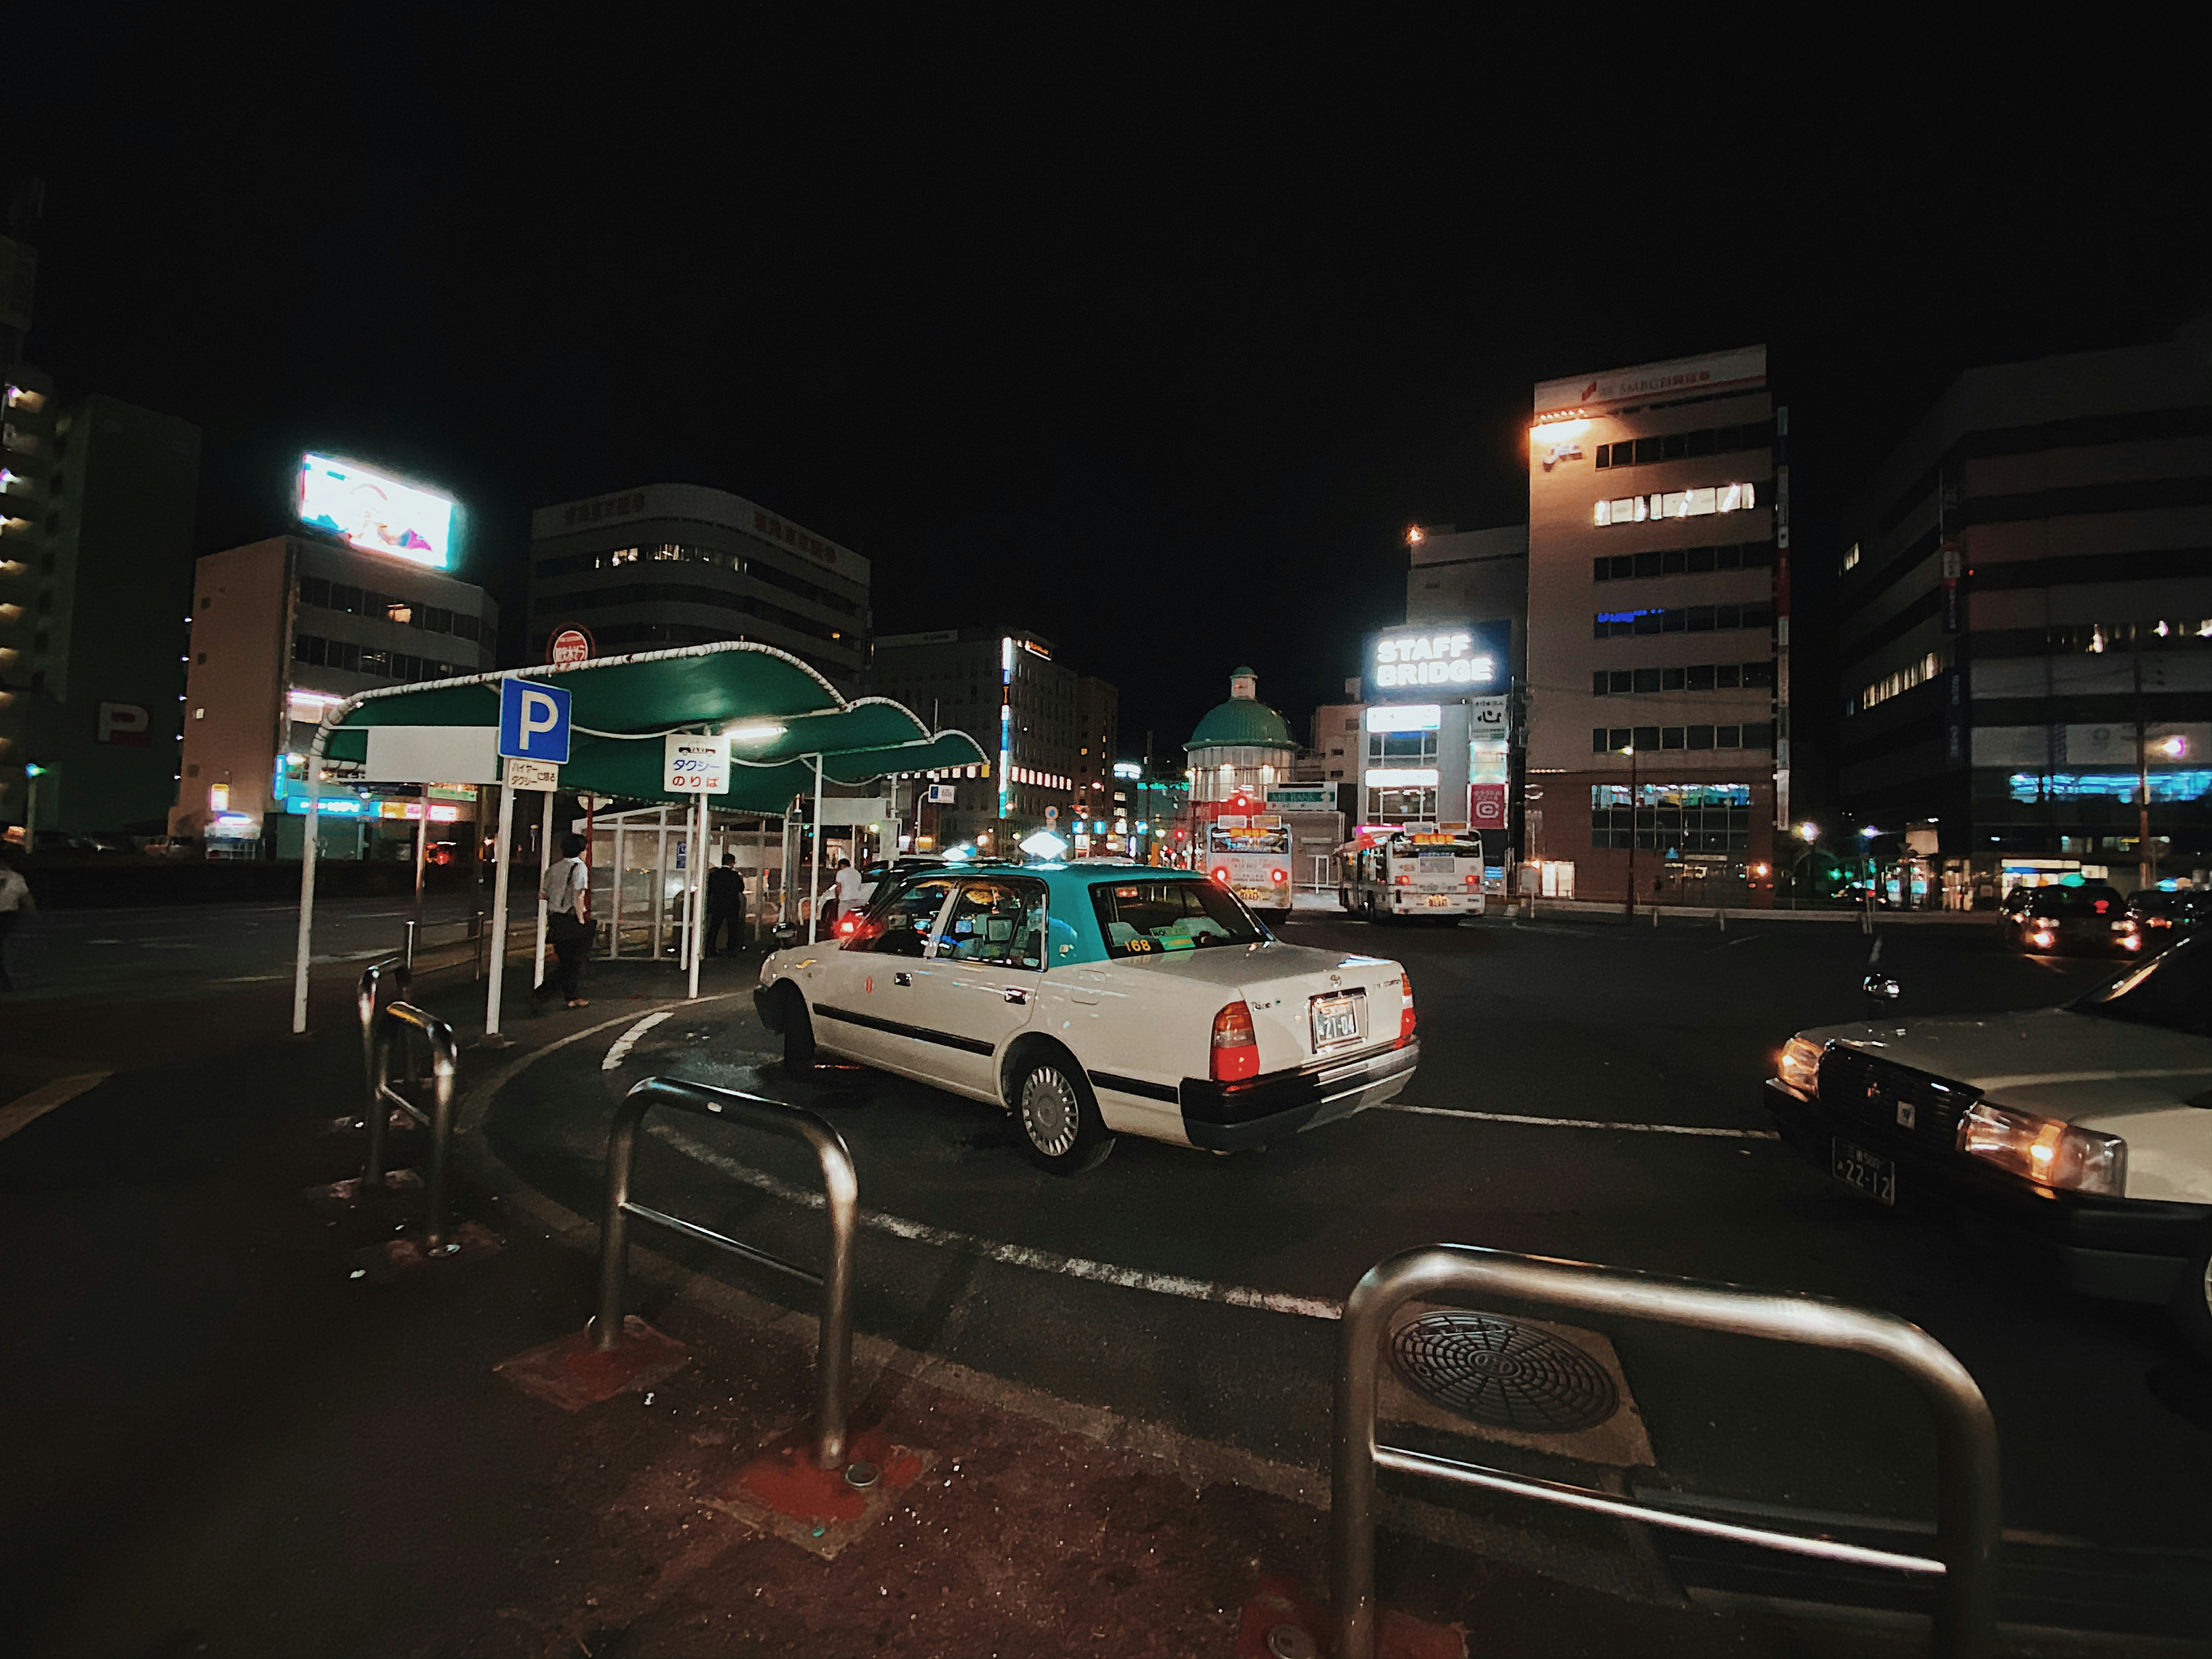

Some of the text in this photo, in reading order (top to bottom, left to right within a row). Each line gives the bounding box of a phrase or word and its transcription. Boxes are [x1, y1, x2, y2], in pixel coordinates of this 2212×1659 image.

[1378, 635, 1471, 663] STAFF
[1378, 658, 1493, 687] BRIDGE
[98, 702, 150, 743] P
[519, 690, 558, 750] P
[512, 763, 538, 773] ハイヤー
[673, 759, 720, 772] タクシー
[511, 775, 537, 786] タクシー
[673, 776, 720, 788] のりば
[1125, 939, 1151, 952] 168
[1323, 1014, 1355, 1039] 21-04
[1846, 1159, 1891, 1200] 22-12
